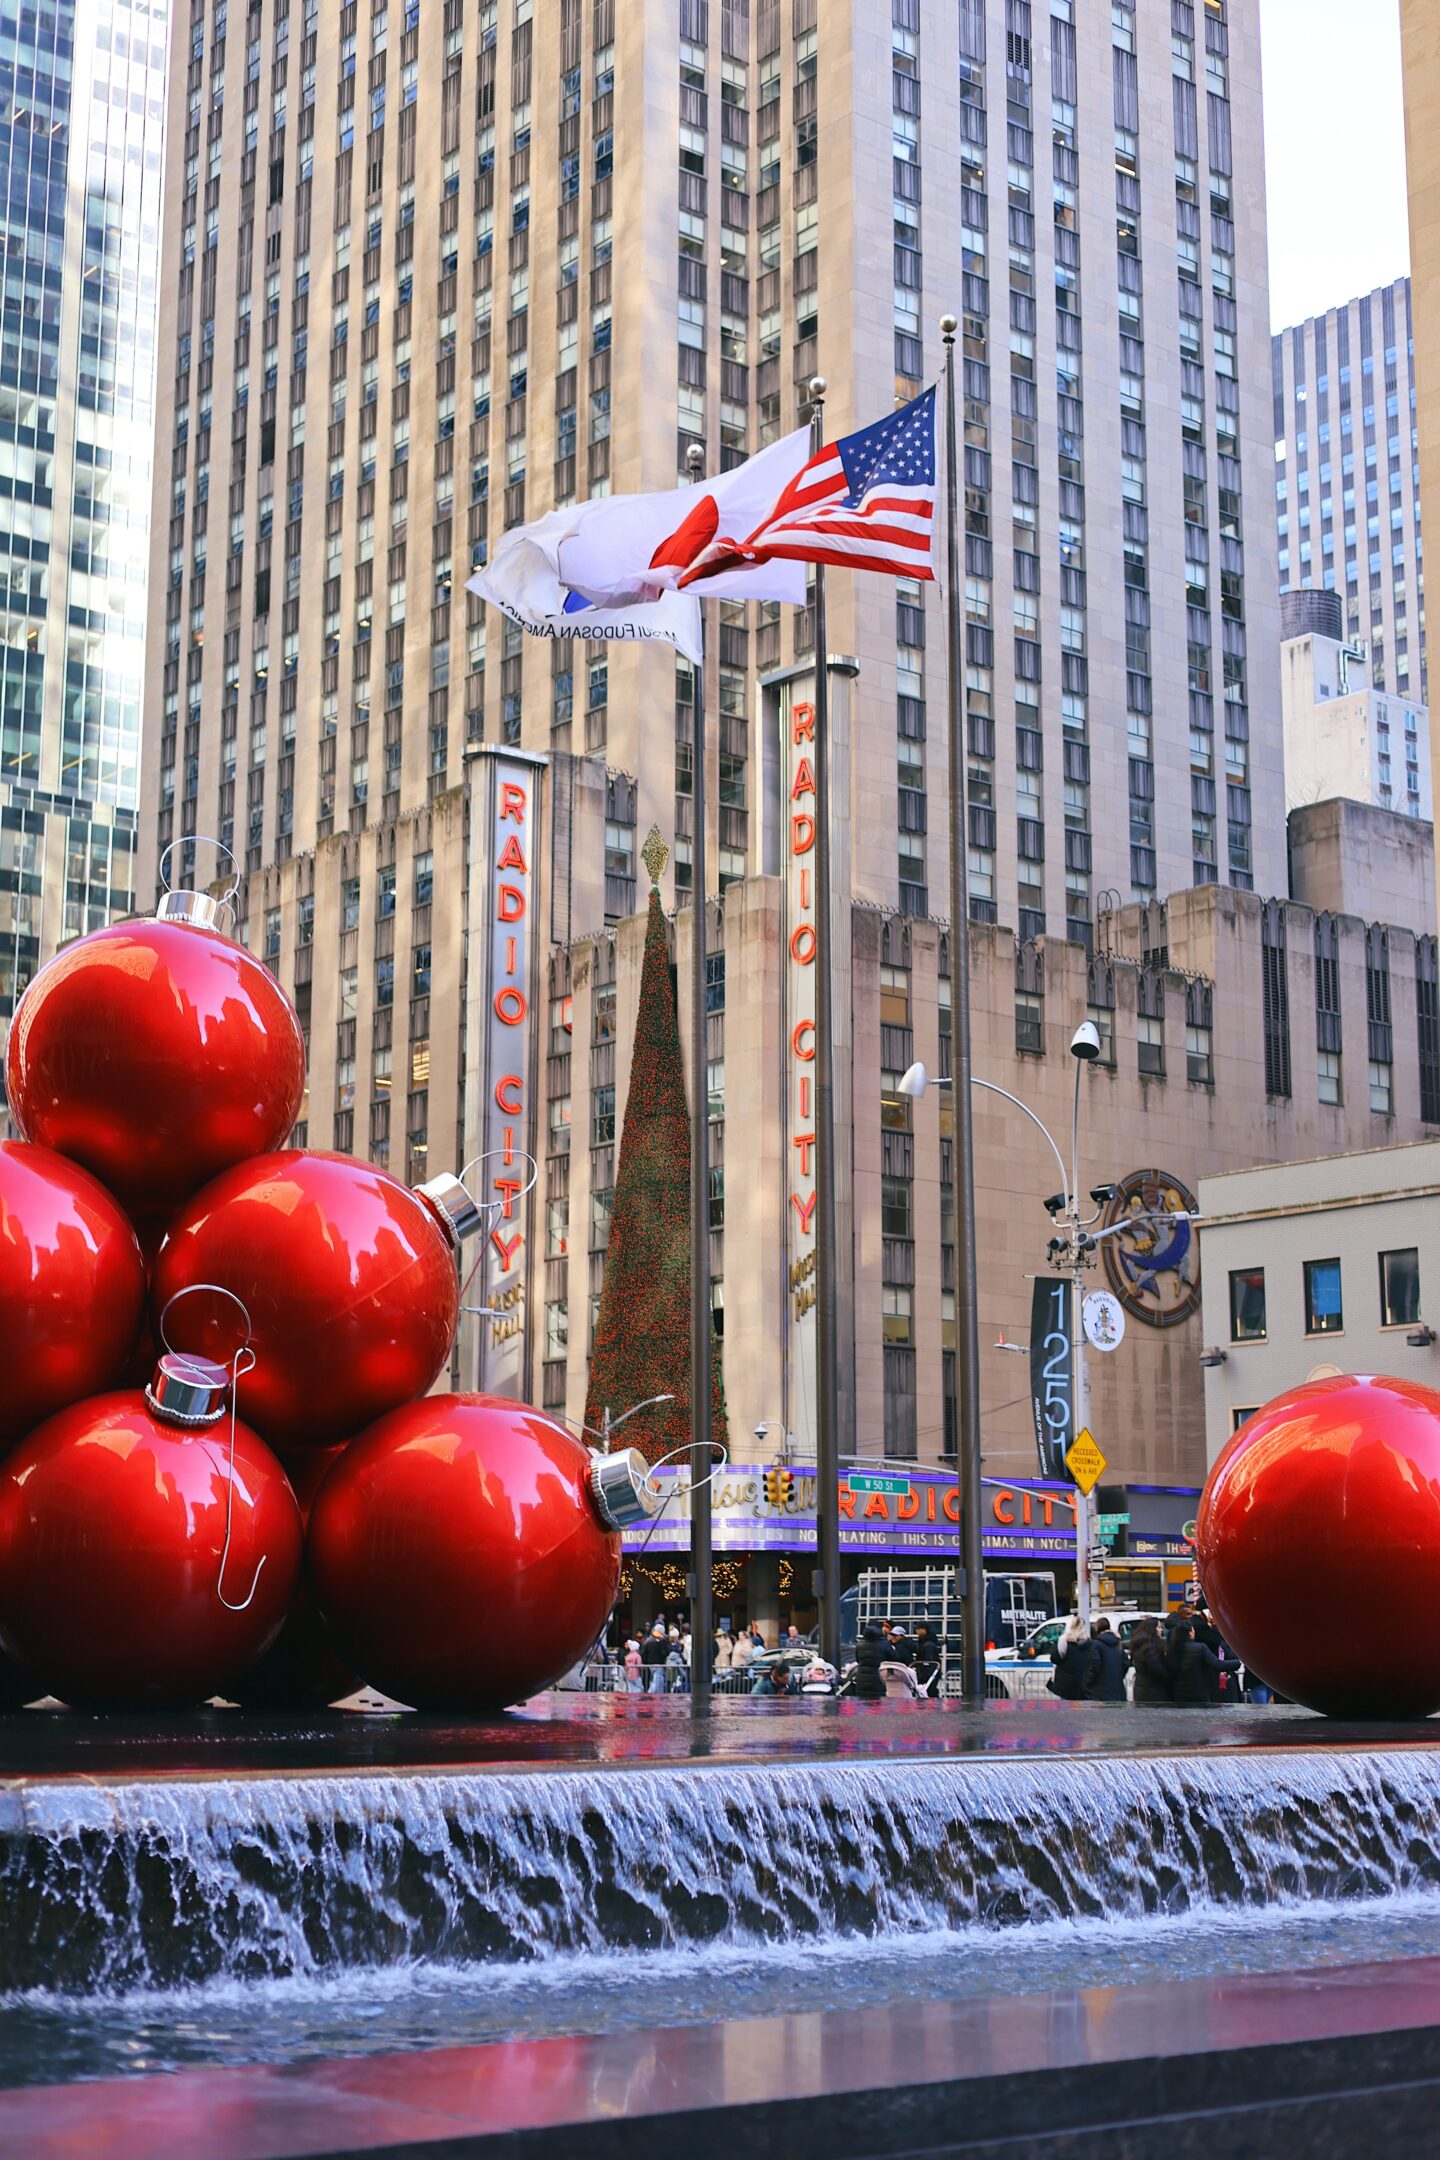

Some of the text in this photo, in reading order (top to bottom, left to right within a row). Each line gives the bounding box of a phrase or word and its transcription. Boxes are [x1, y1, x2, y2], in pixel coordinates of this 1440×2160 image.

[789, 702, 816, 1235] RADIO CITY
[490, 782, 527, 1271] RADIO CITY
[491, 1313, 524, 1350] HALL
[1043, 1283, 1070, 1477] 1251
[838, 1483, 960, 1522] RADIO
[865, 1480, 894, 1492] W 50 St
[902, 1533, 927, 1545] THIS
[934, 1534, 945, 1546] IS
[1023, 1537, 1034, 1549] IN
